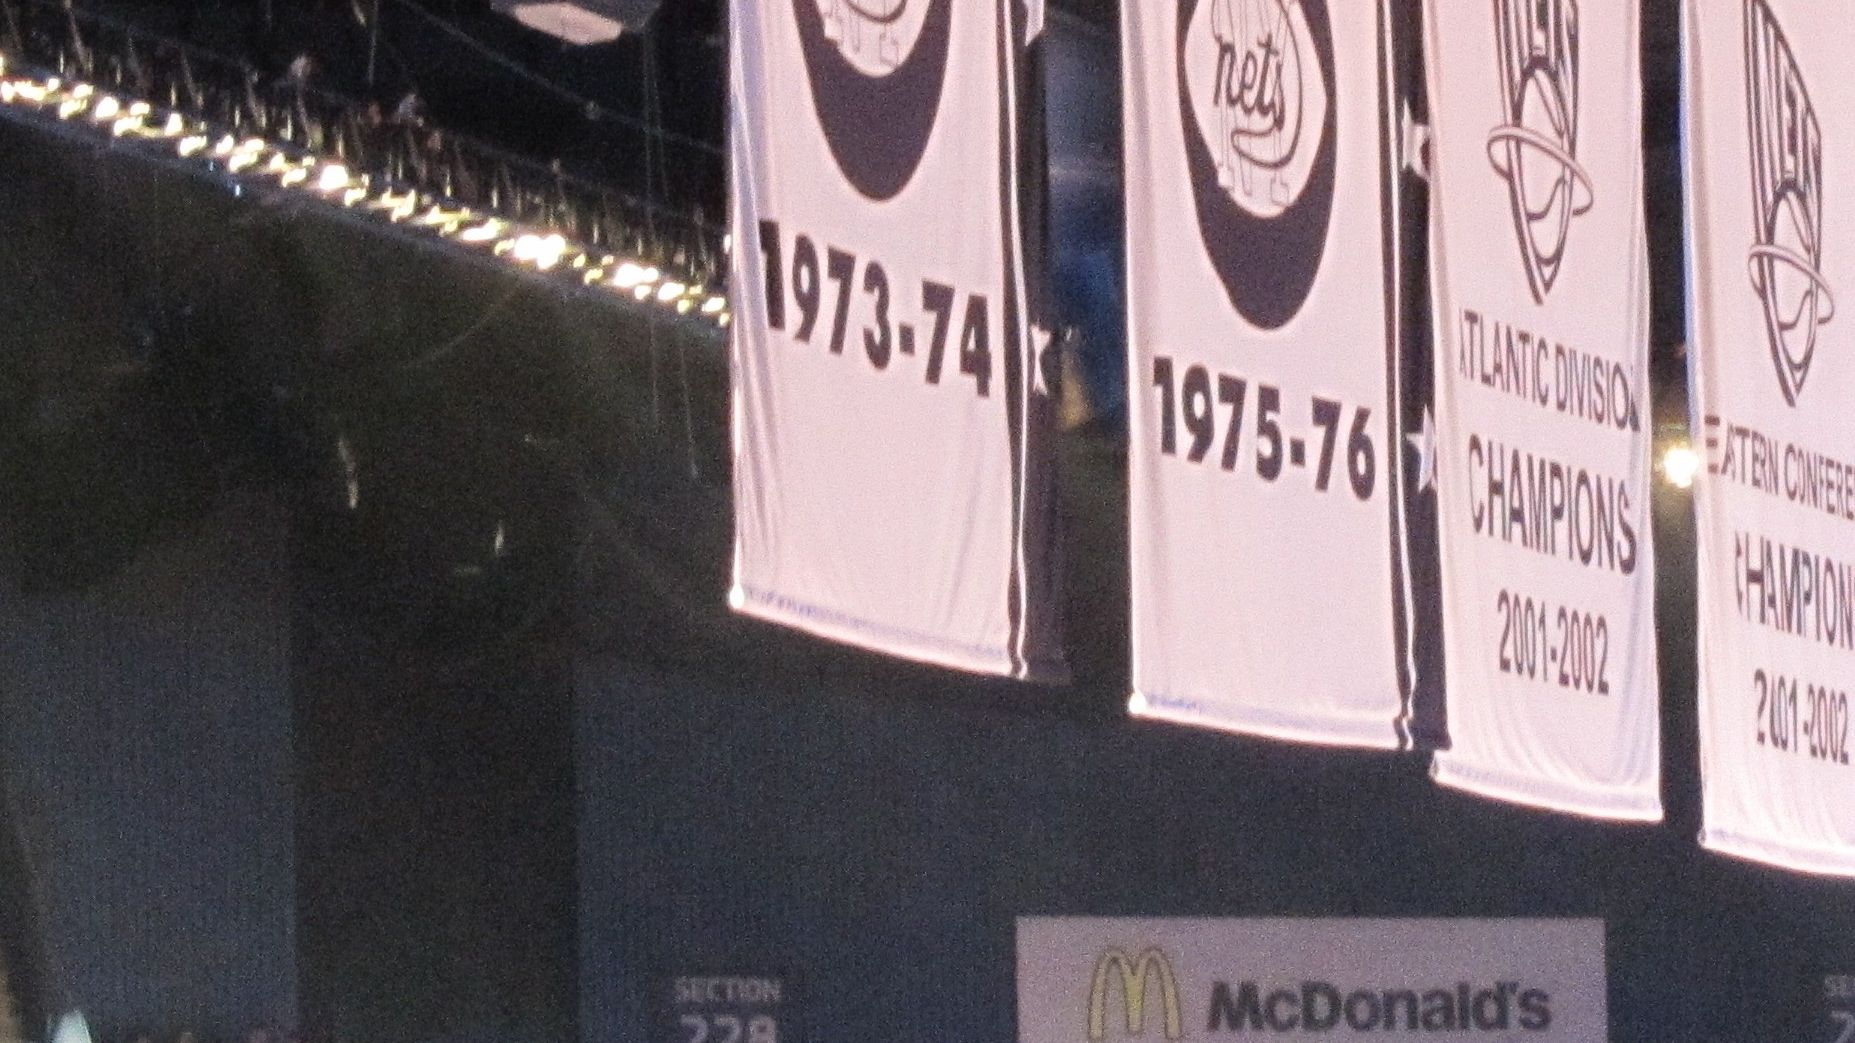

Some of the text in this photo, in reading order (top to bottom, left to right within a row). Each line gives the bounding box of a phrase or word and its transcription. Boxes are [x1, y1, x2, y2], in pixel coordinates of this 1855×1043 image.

[759, 219, 992, 398] 1973-74
[1153, 355, 1376, 500] 1975-76
[1468, 433, 1637, 575] CHAMPIONS
[1498, 588, 1610, 696] 2001-2002
[674, 977, 780, 1003] SECTION
[1206, 981, 1554, 1033] McDonald's
